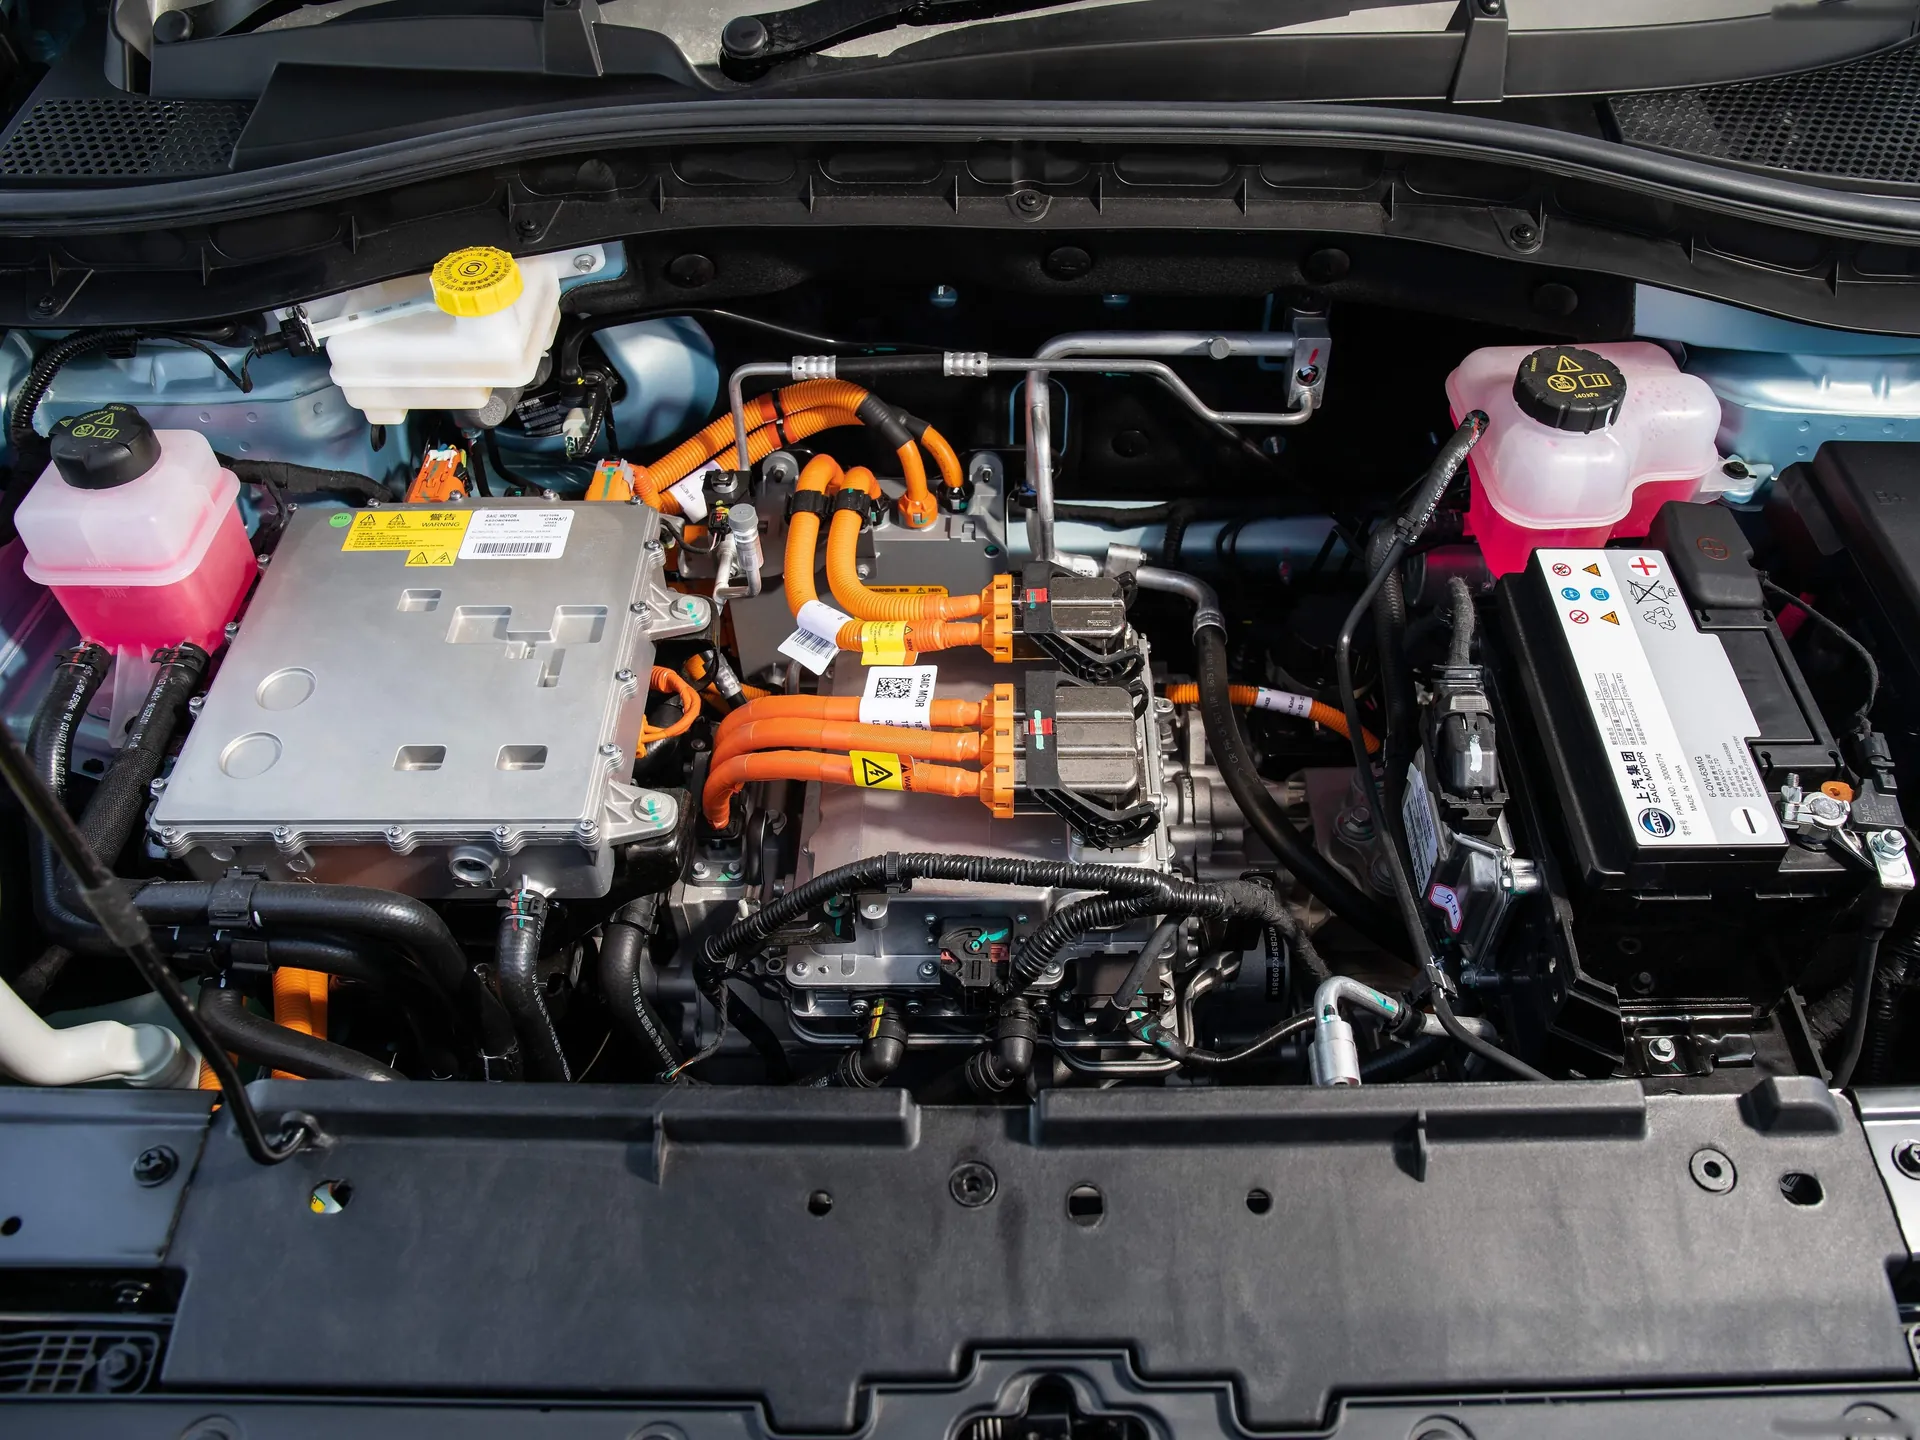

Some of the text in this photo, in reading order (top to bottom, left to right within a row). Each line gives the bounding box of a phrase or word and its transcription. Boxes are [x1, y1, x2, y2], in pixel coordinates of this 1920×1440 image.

[1620, 751, 1652, 803] 上汽集团
[1637, 751, 1661, 803] SAIC MOTOR
[1675, 765, 1686, 783] CHINA
[1695, 756, 1717, 798] 6-QW-63MG
[1672, 798, 1684, 815] PART
[1686, 794, 1697, 811] MADE
